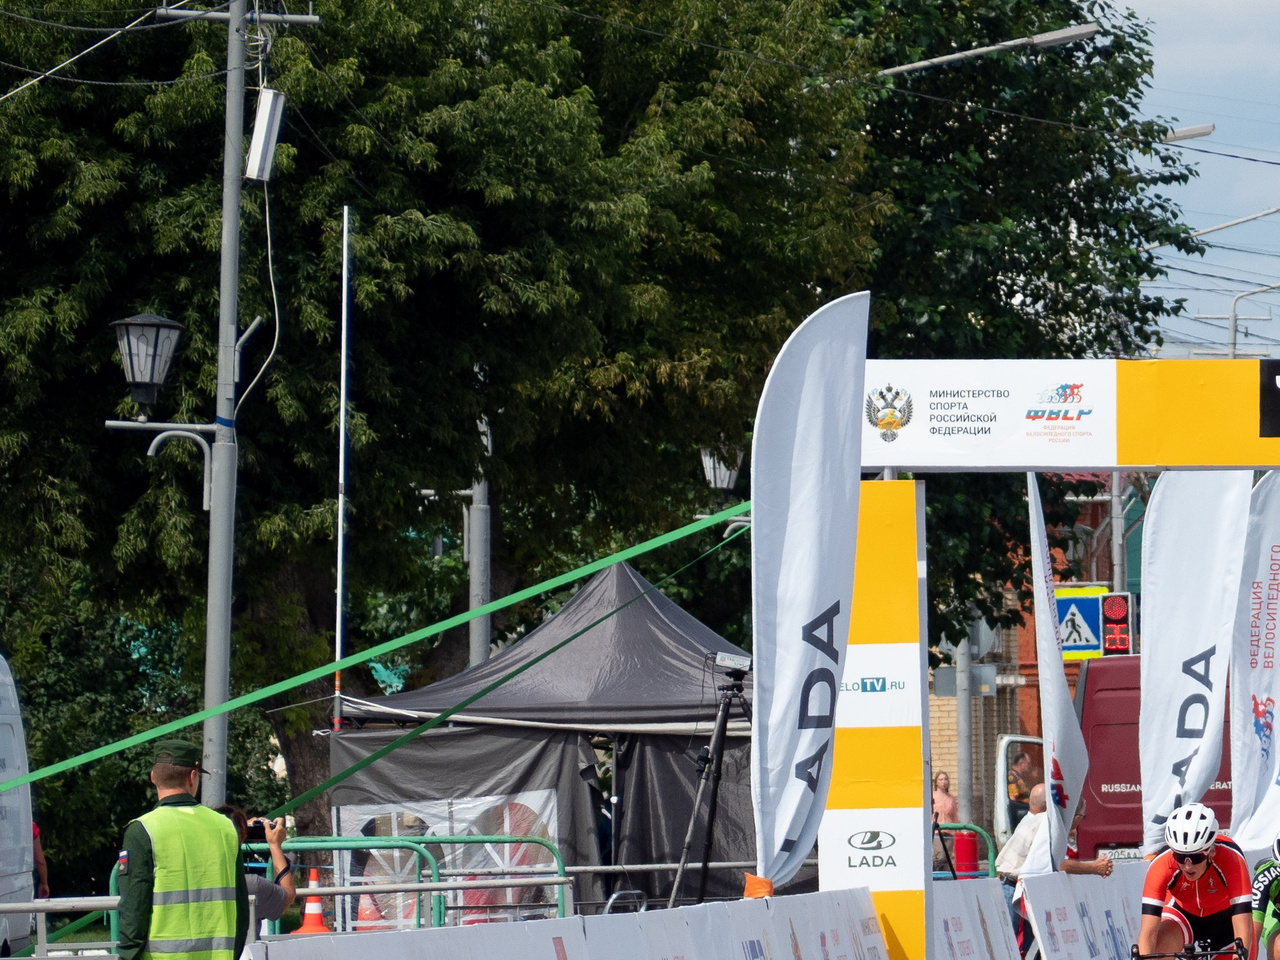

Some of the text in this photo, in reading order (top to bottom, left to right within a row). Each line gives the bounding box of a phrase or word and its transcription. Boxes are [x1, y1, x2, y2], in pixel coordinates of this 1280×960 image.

[929, 389, 1010, 399] МИНИСТЕРСТВО
[929, 401, 969, 411] СПОРТА
[929, 412, 998, 423] РОССИЙСКОЙ
[929, 426, 992, 436] ФЕДЕРАЦИИ
[1250, 581, 1264, 669] ФЕДЕРАЦИЯ
[839, 677, 906, 694] ELOTV.RU
[1101, 783, 1142, 793] RUSSIAN
[848, 855, 897, 868] LADA
